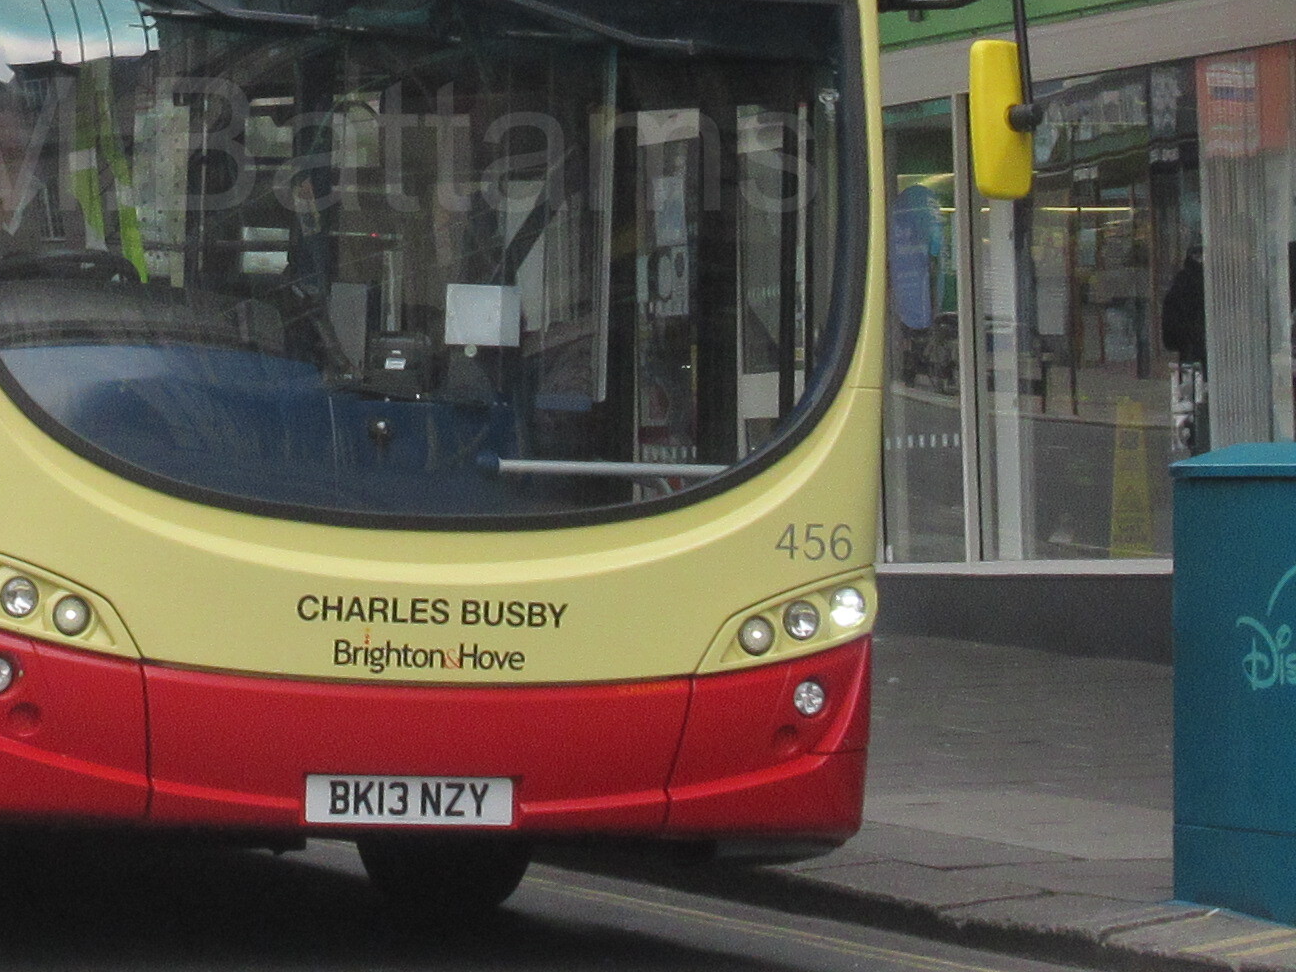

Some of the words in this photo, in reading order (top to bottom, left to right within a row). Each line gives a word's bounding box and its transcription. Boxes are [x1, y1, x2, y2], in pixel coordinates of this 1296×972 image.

[775, 523, 853, 561] 456
[296, 594, 450, 625] CHARLES
[460, 599, 569, 628] BUSBY
[333, 636, 526, 674] Brighton&Hove
[328, 780, 410, 816] BK13
[420, 782, 490, 818] NZY
